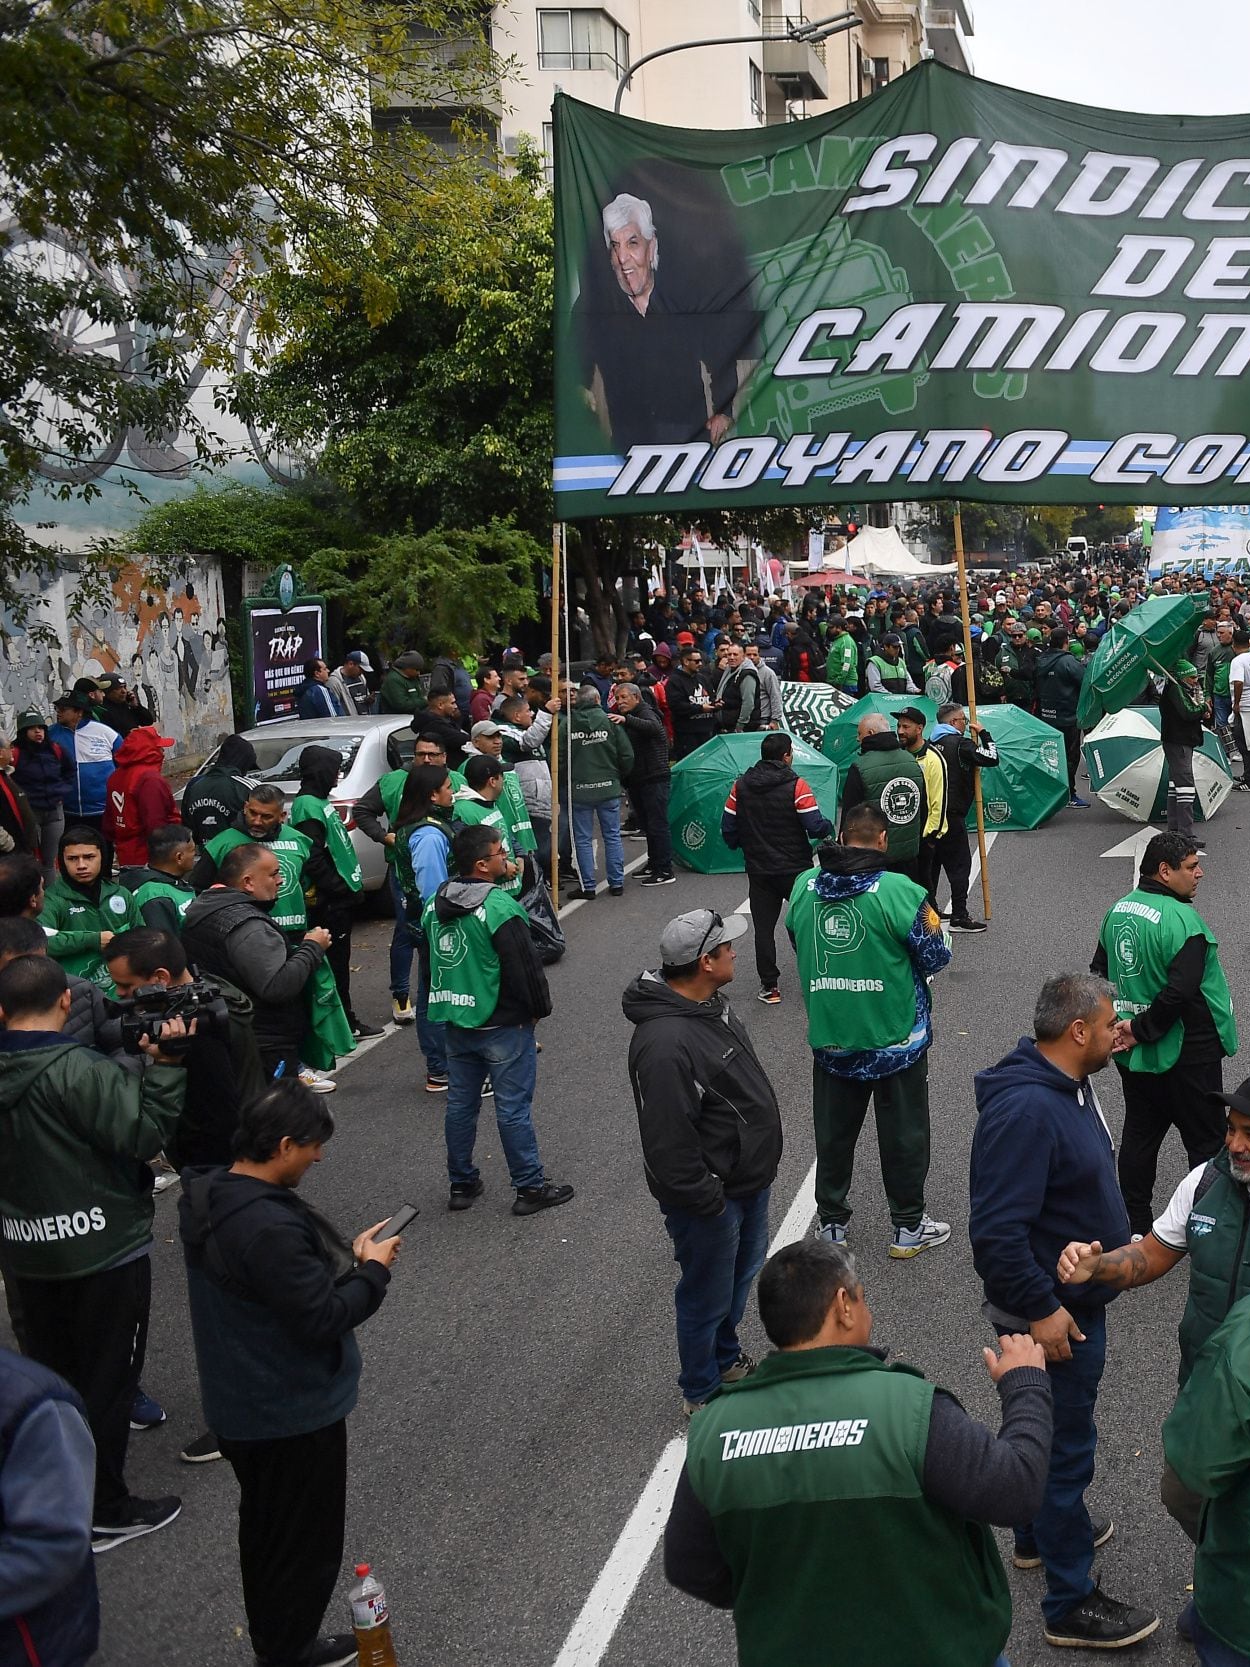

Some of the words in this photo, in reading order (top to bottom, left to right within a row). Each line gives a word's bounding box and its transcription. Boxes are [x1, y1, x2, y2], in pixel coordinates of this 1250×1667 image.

[607, 430, 1069, 497] MOYANO
[1168, 504, 1249, 516] SCATO
[268, 633, 303, 660] TRAP
[188, 798, 231, 817] CAMIONEROS
[1113, 901, 1162, 925] SEGURIDAD
[2, 1206, 106, 1242] MIONEROS
[719, 1418, 869, 1461] CAMIONEROS
